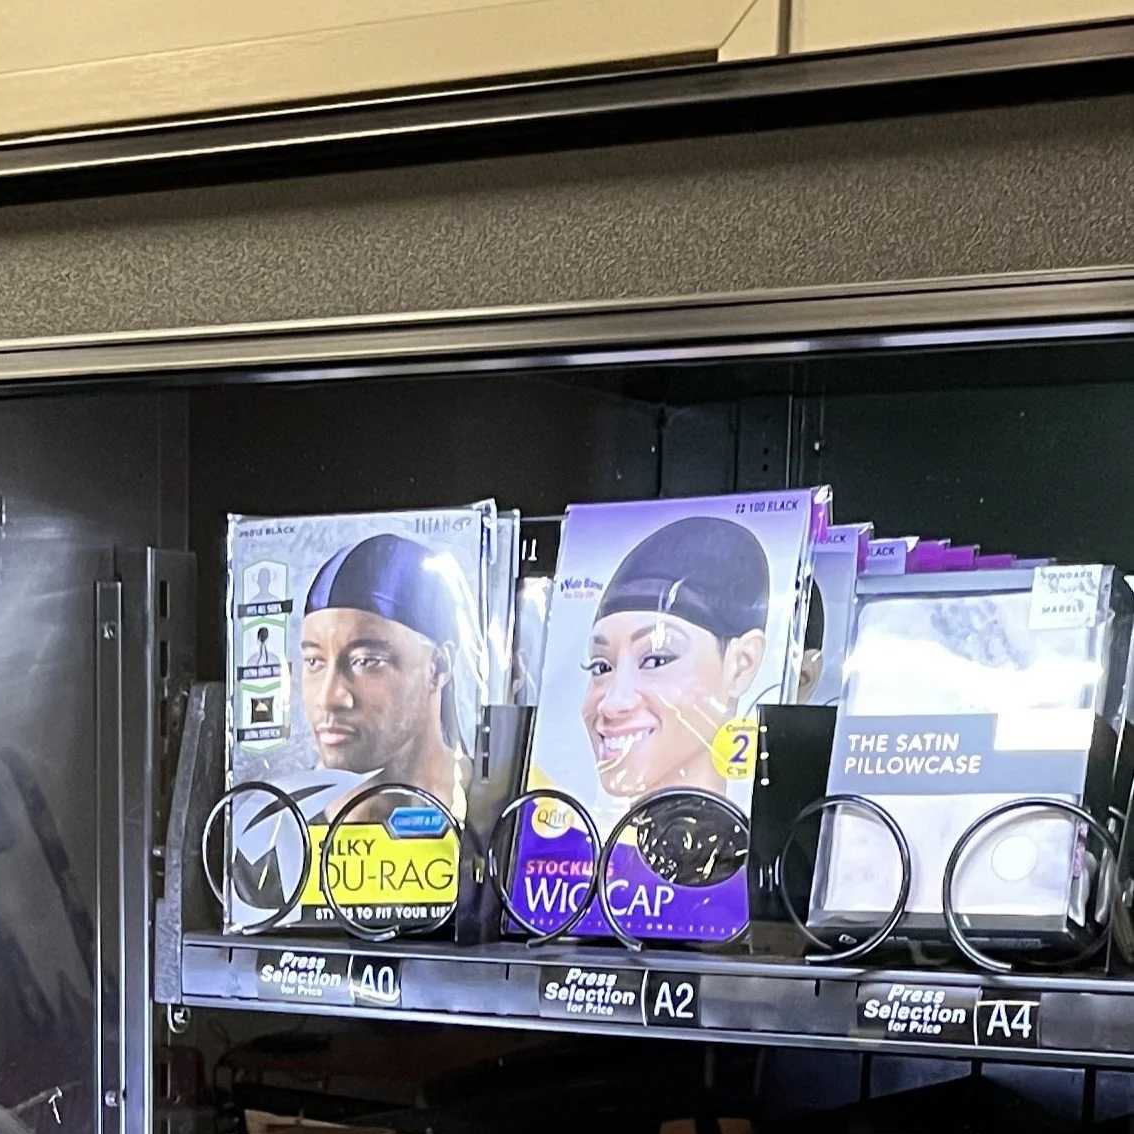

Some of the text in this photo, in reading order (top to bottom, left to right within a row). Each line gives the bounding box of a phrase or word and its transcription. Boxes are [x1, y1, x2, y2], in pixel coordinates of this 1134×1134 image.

[768, 500, 798, 512] BLACK
[266, 526, 295, 535] BLACK
[729, 734, 749, 763] 2
[848, 732, 960, 752] THE SATIN
[844, 755, 982, 775] PILLOWCASE
[319, 858, 454, 891] DU-RAG
[605, 879, 675, 917] CAP
[357, 907, 373, 919] TO
[375, 906, 392, 919] FIT
[395, 906, 428, 918] YOUR
[566, 968, 617, 987] Press
[544, 982, 635, 1005] Selection
[654, 982, 694, 1018] A2
[888, 984, 945, 1003] Press
[567, 1002, 613, 1015] for Price
[864, 1000, 966, 1024] Selection
[888, 1020, 941, 1034] for Price
[987, 1000, 1032, 1038] A4
